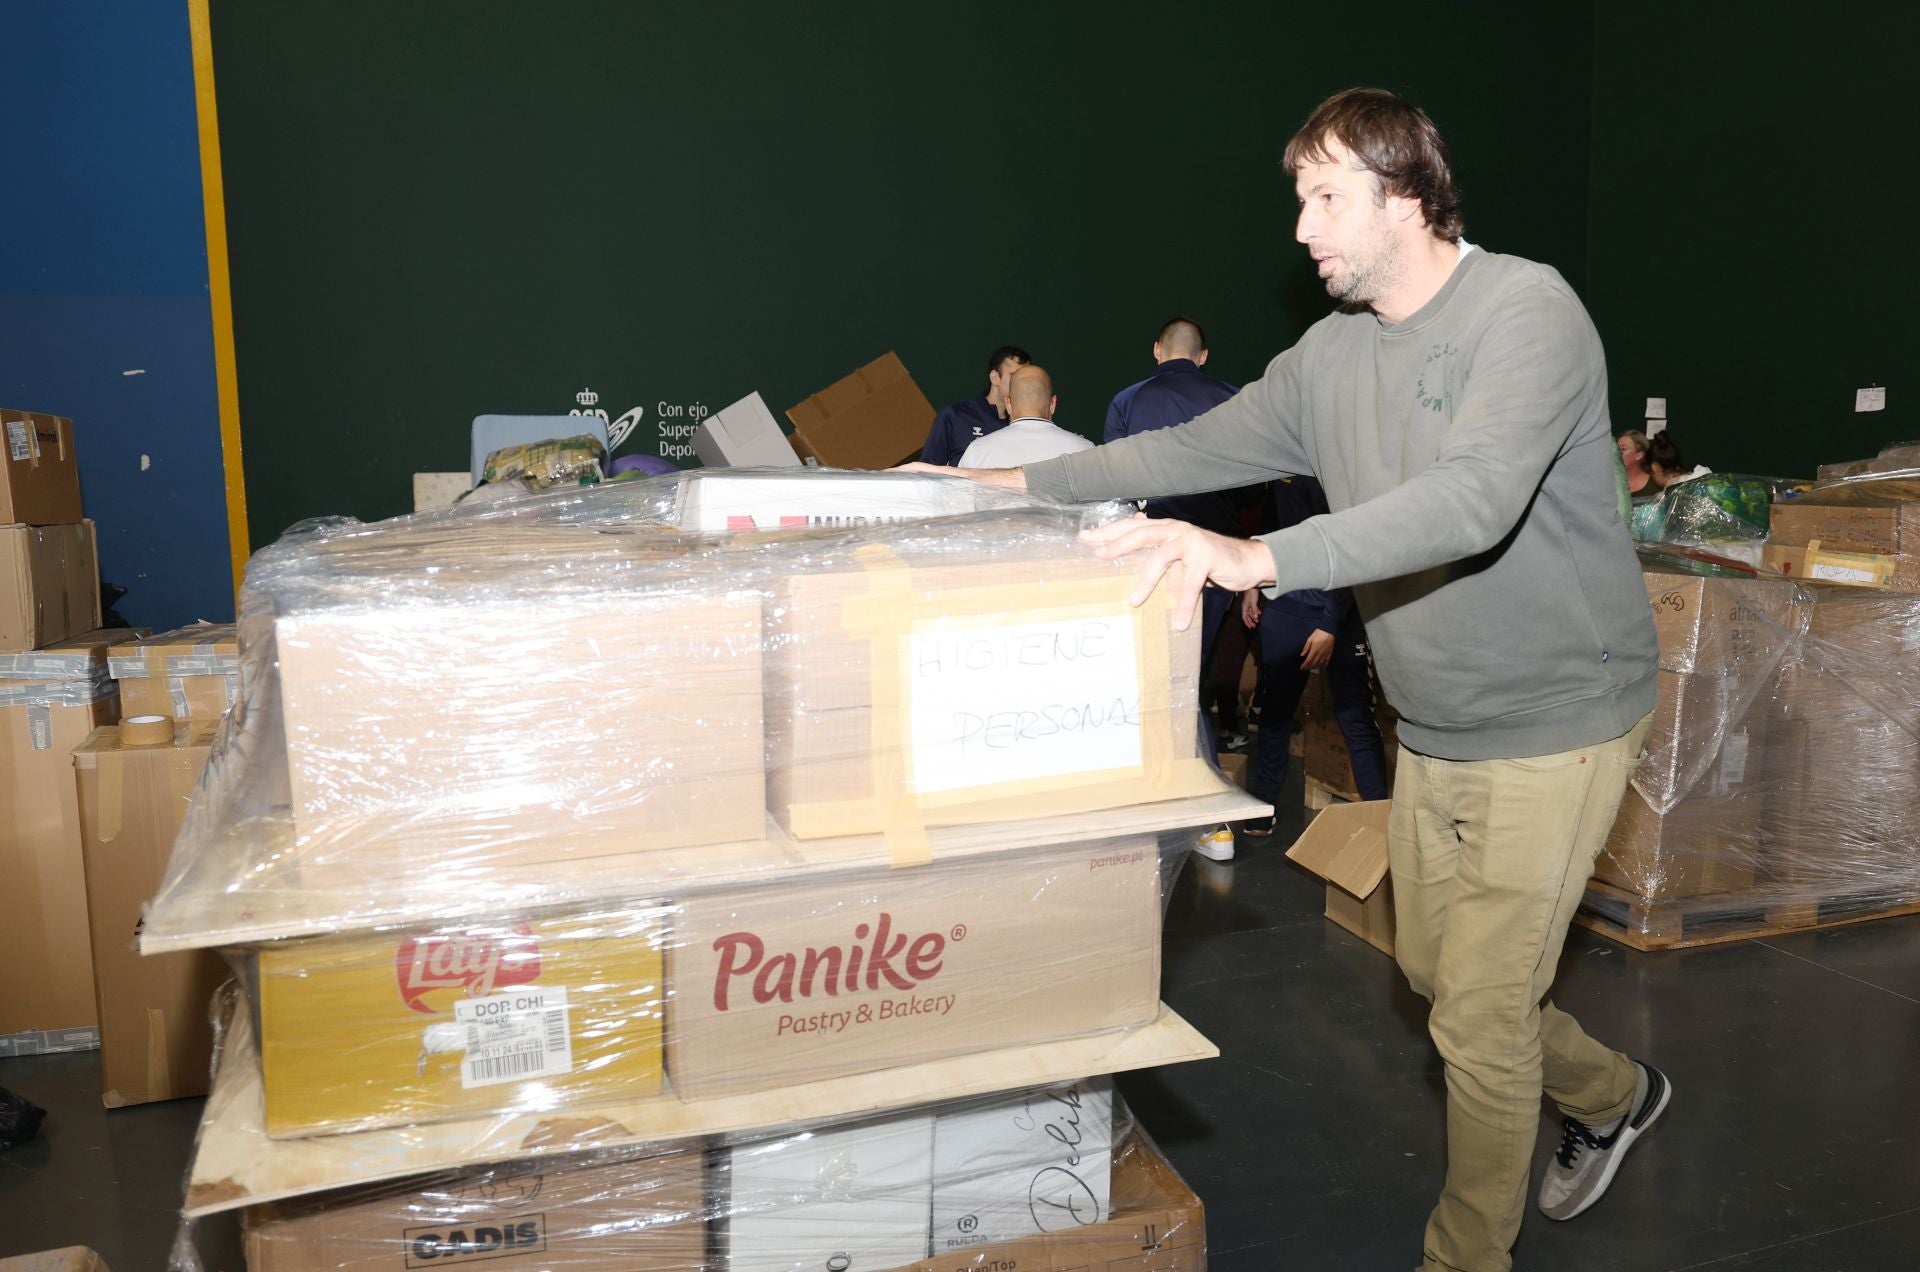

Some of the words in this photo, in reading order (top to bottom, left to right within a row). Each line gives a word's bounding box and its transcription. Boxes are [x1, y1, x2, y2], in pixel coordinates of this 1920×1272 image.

[916, 622, 1111, 678] HIGIENE
[777, 1009, 852, 1036] Pastry
[855, 1003, 873, 1024] &
[878, 993, 956, 1020] Bakery
[946, 1234, 988, 1248] RUEDA
